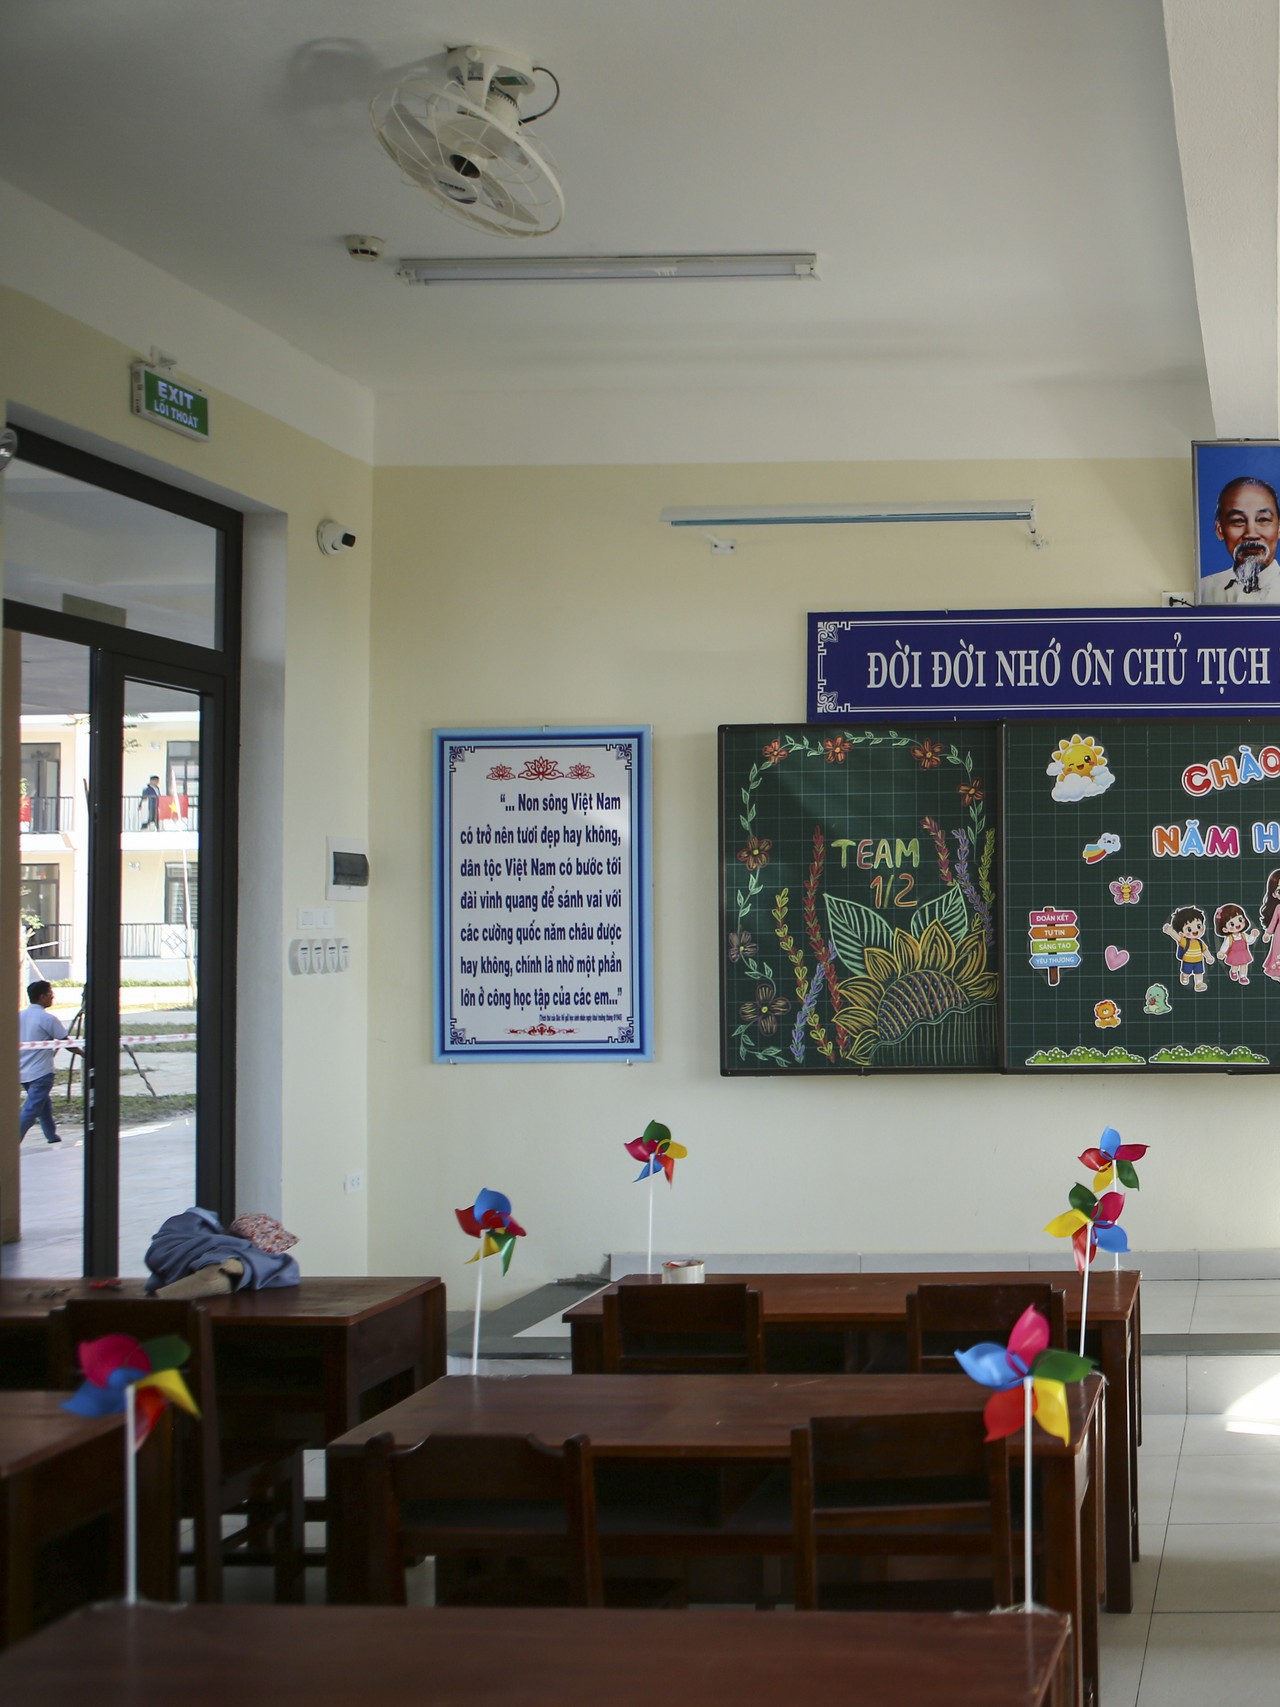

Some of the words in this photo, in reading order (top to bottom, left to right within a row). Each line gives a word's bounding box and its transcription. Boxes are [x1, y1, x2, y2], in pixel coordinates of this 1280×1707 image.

[158, 380, 194, 409] EXIT
[154, 399, 169, 416] LỐI
[171, 407, 198, 428] THOÁT
[866, 639, 922, 688] ĐỜI
[931, 638, 986, 688] ĐỜI
[995, 637, 1061, 687] NHỚ
[1071, 642, 1114, 686] ƠN
[1123, 632, 1188, 686] CHỦ
[1197, 647, 1271, 695] TỊCH
[518, 794, 539, 811] Non
[542, 794, 568, 814] sông
[571, 792, 592, 815] Việt
[596, 792, 621, 810] Nam
[460, 826, 473, 844] có
[477, 824, 491, 844] trở
[495, 828, 513, 844] nên
[517, 826, 537, 844] tươi
[541, 826, 560, 848] đẹp
[563, 826, 582, 846] hay
[585, 825, 621, 846] không,
[1152, 819, 1240, 858] NĂM
[831, 838, 919, 869] TEAM
[460, 859, 480, 876] dân
[484, 859, 501, 881] tộc
[505, 858, 527, 881] Việt
[531, 858, 555, 875] Nam
[559, 858, 572, 875] có
[576, 857, 603, 875] bước
[607, 857, 621, 875] tới
[460, 891, 476, 909] đài
[480, 891, 502, 908] vinh
[505, 894, 538, 912] quang
[542, 886, 555, 908] để
[558, 890, 583, 908] sánh
[587, 890, 602, 907] vai
[606, 889, 621, 907] với
[870, 873, 917, 909] 1/2
[460, 924, 479, 941] các
[482, 924, 513, 944] cường
[516, 920, 541, 944] quốc
[544, 923, 565, 940] năm
[569, 923, 593, 940] châu
[597, 923, 621, 945] được
[460, 957, 478, 977] hay
[481, 956, 513, 977] không,
[516, 955, 542, 973] chính
[545, 955, 553, 972] là
[557, 955, 574, 972] nhờ
[577, 956, 595, 978] một
[599, 952, 622, 976] phần
[460, 988, 475, 1006] lớn
[479, 986, 485, 1006] ở
[487, 989, 510, 1009] công
[514, 989, 531, 1010] học
[535, 988, 549, 1010] tập
[553, 986, 570, 1005] của
[574, 987, 591, 1005] các
